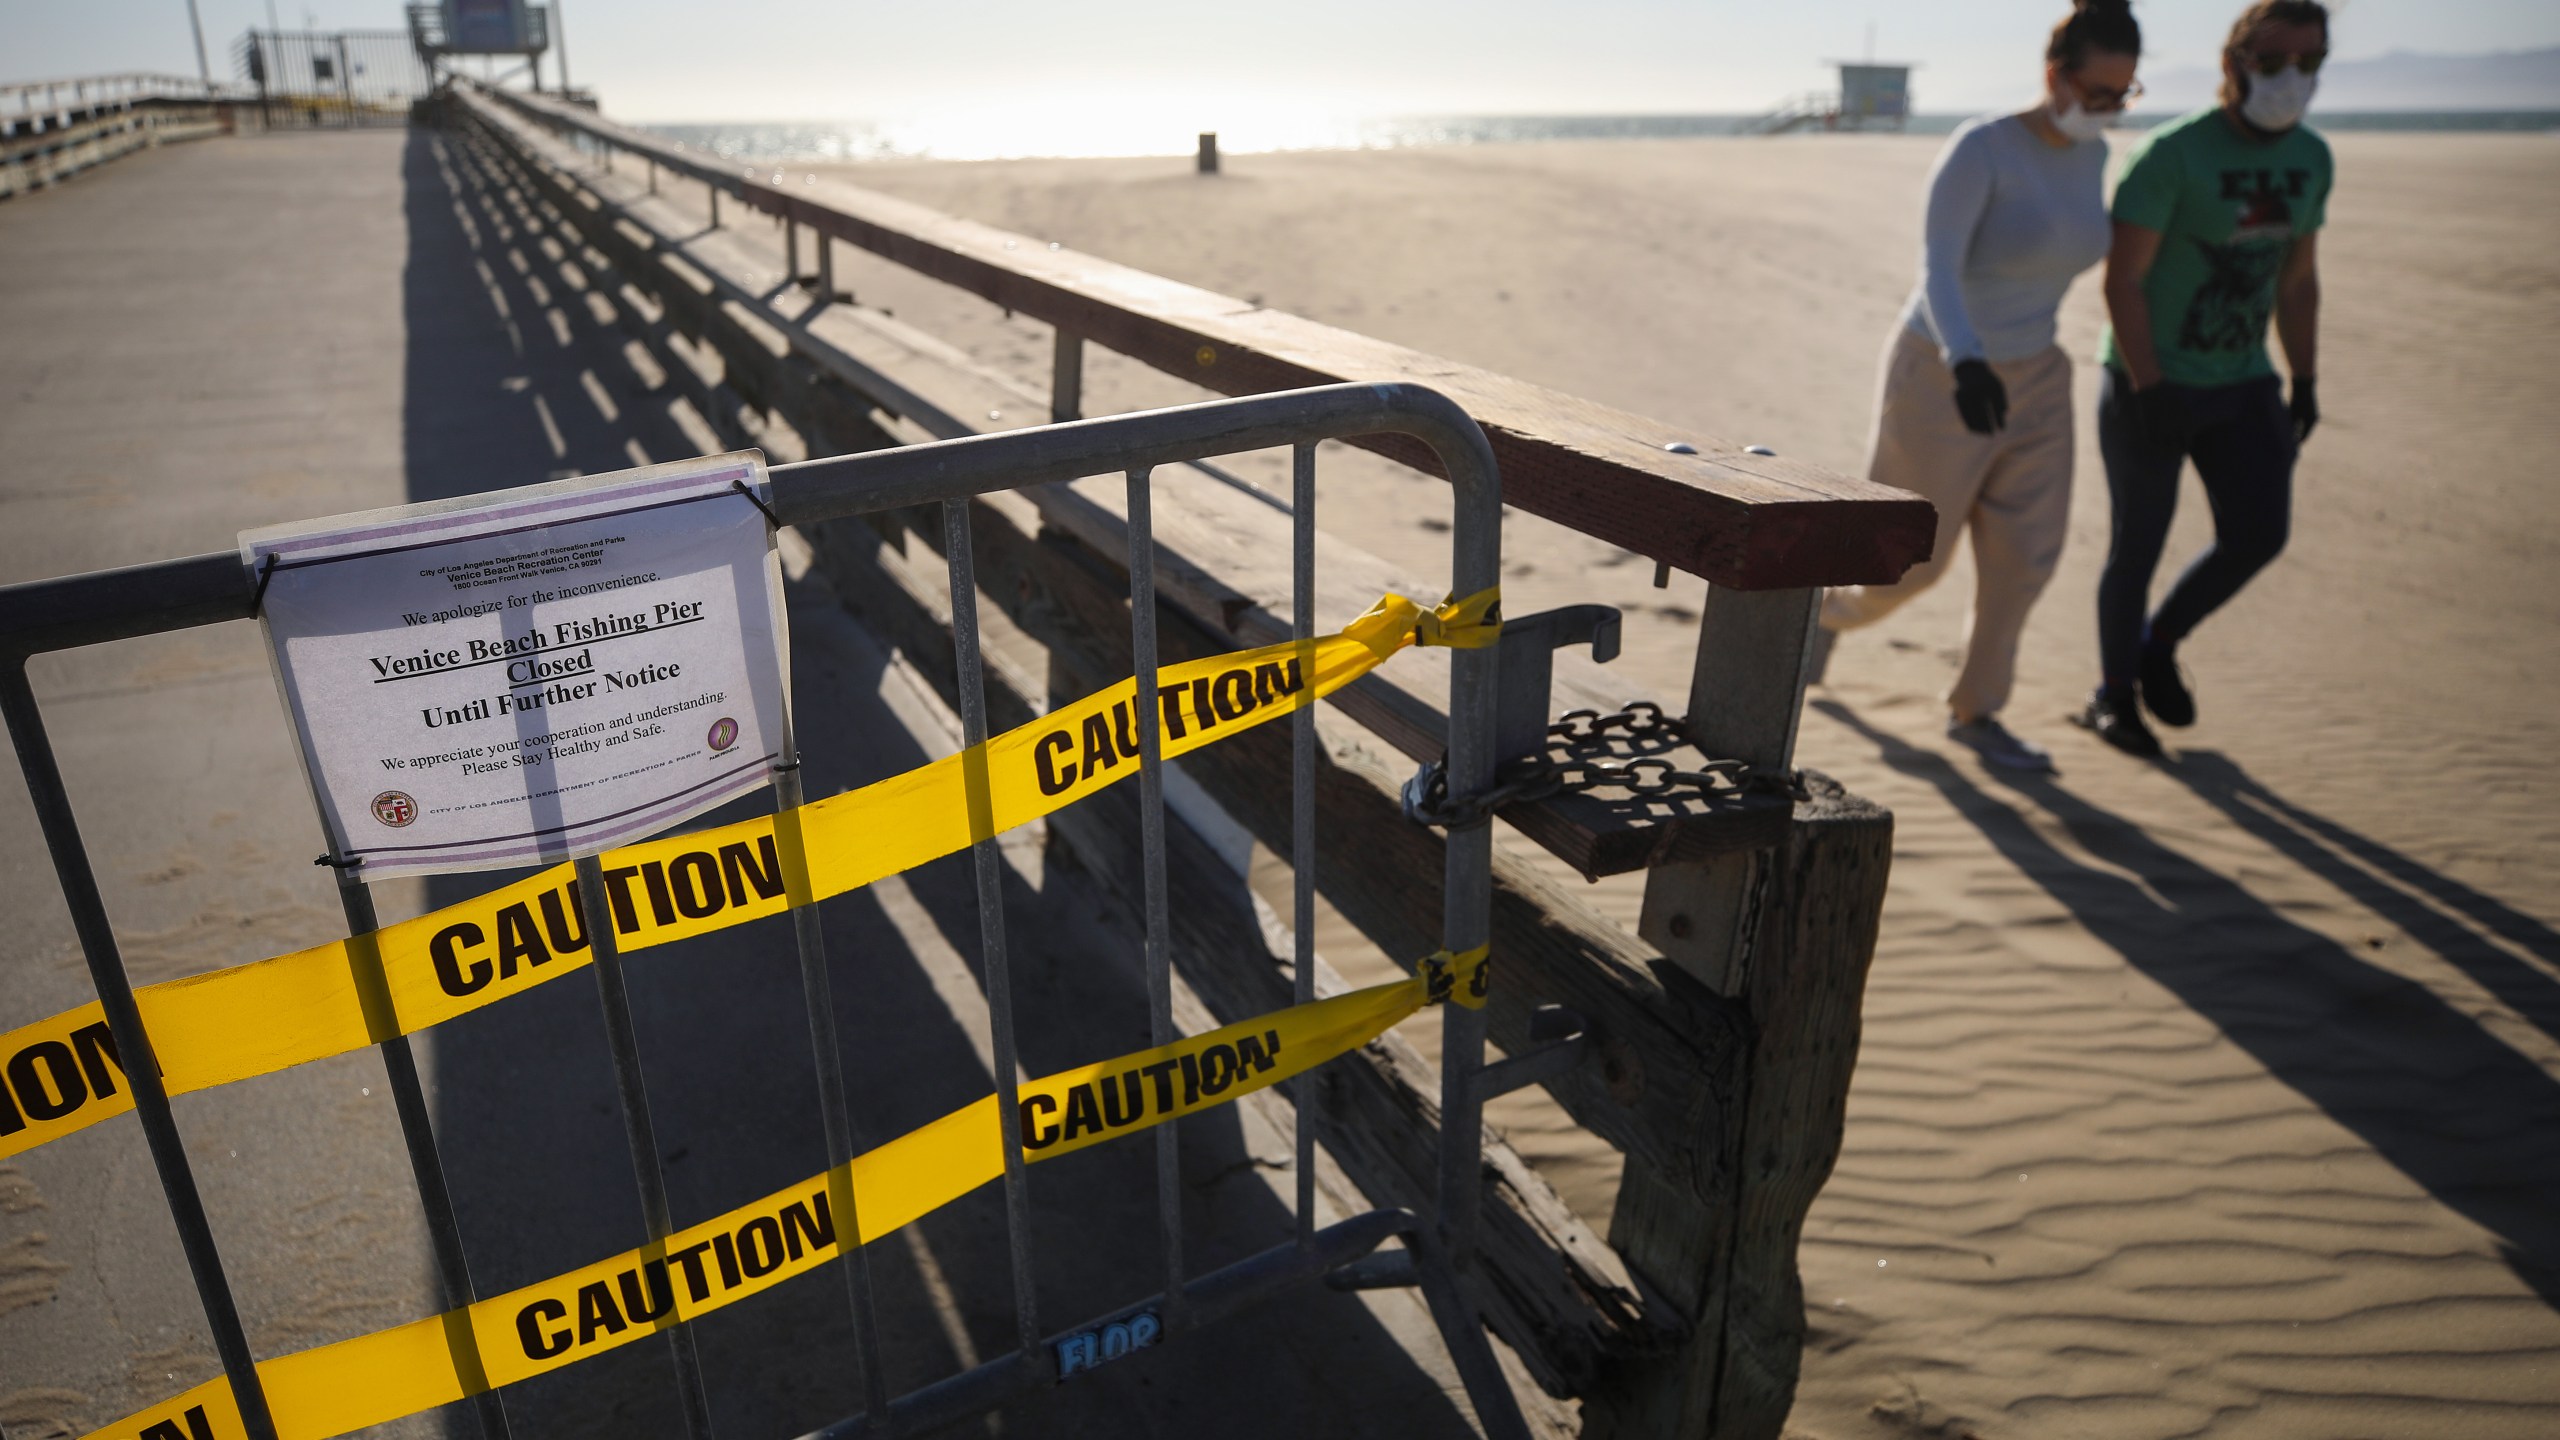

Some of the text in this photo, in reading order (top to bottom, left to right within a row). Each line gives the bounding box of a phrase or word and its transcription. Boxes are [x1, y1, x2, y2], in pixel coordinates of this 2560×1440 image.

[419, 535, 626, 578] City of Los Angeles Department of Recreation and Parks
[447, 548, 604, 583] Venice Beach Recreation Center
[453, 557, 602, 591] 1800 Ocean Front Walk Venice, CA 90291
[401, 571, 662, 628] We apologize for the inconvenience.
[368, 600, 704, 679] Venice Beach Fishing Pier
[506, 648, 594, 684] Closed
[420, 660, 682, 729] Until Further Notice
[1033, 656, 1306, 797] CAUTION
[381, 690, 728, 771] We appreciate your cooperation and understanding.
[461, 723, 666, 777] Please Stay Healthy and Safe.
[429, 806, 452, 815] CITY
[454, 804, 467, 812] OF
[469, 802, 488, 810] LOS
[490, 794, 533, 806] ANGELES
[535, 781, 596, 798] DEPARTMENT
[597, 776, 611, 785] OF
[612, 761, 666, 782] RECREATION
[676, 749, 702, 763] PARKS
[428, 834, 788, 998] CAUTION
[1017, 1029, 1280, 1150] CAUTION
[515, 1190, 838, 1361] CAUTION
